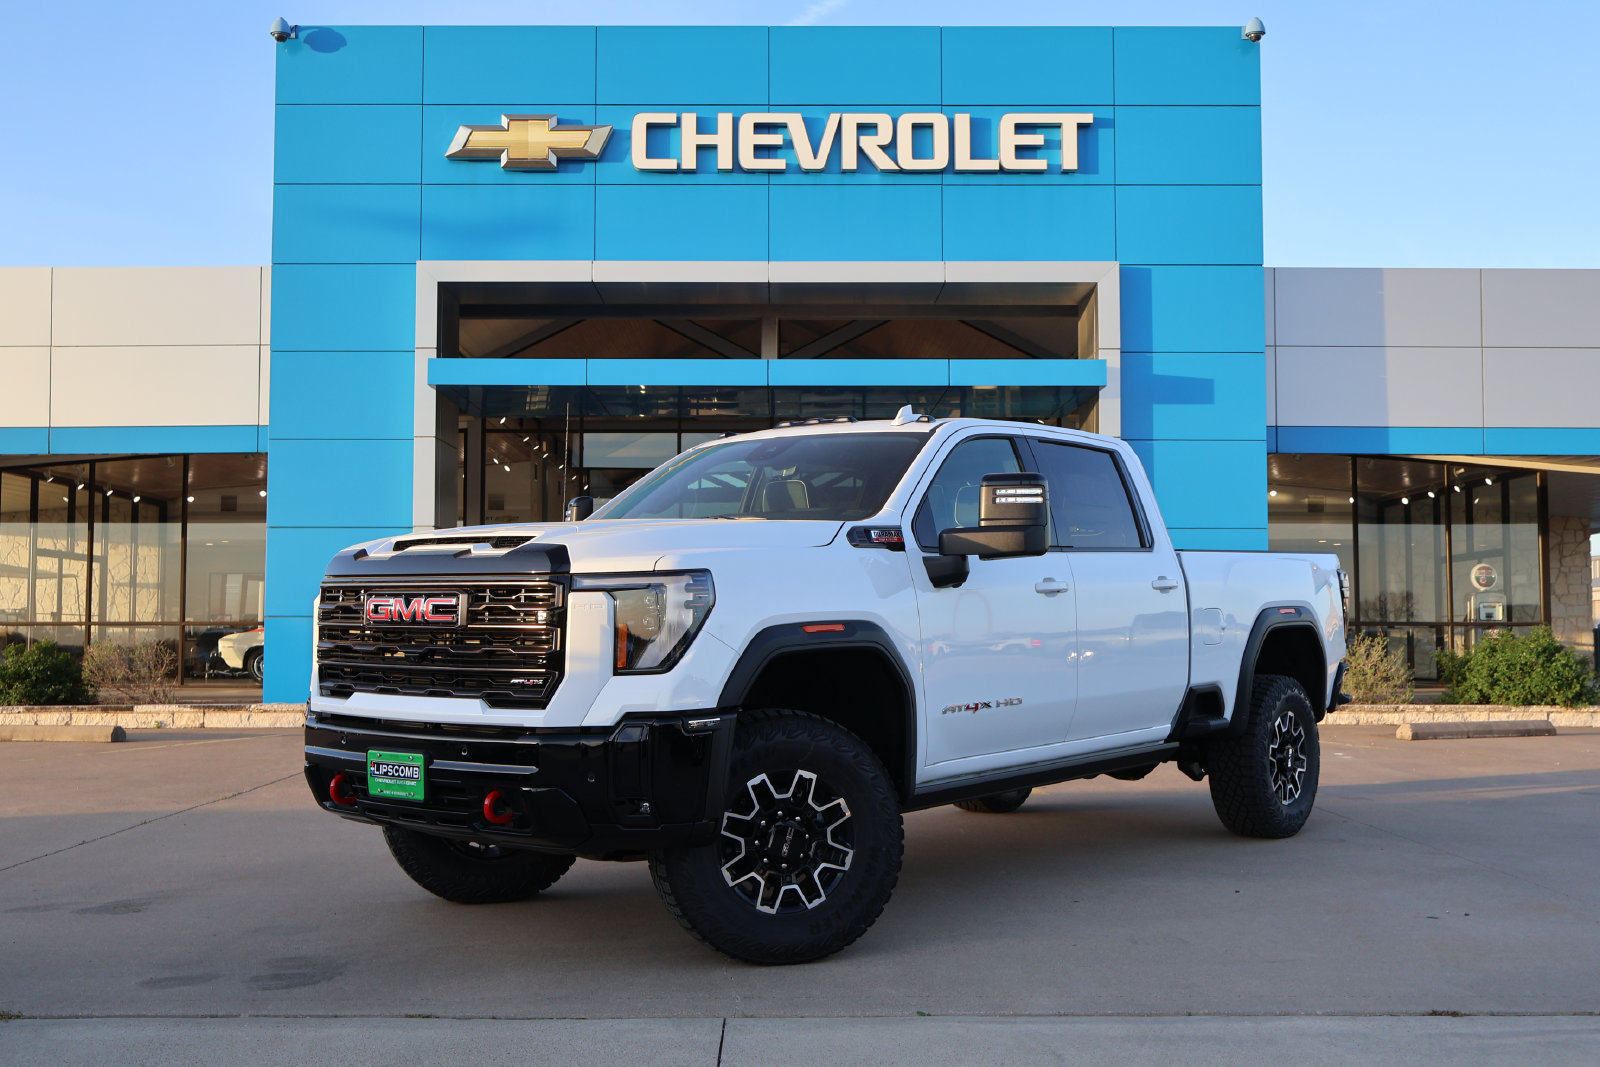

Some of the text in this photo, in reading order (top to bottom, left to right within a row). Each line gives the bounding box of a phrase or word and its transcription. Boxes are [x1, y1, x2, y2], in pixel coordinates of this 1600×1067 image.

[631, 112, 1094, 173] CHEVROLET
[367, 597, 457, 622] GMC
[996, 697, 1023, 708] HD
[374, 764, 419, 778] LIPSCOMB
